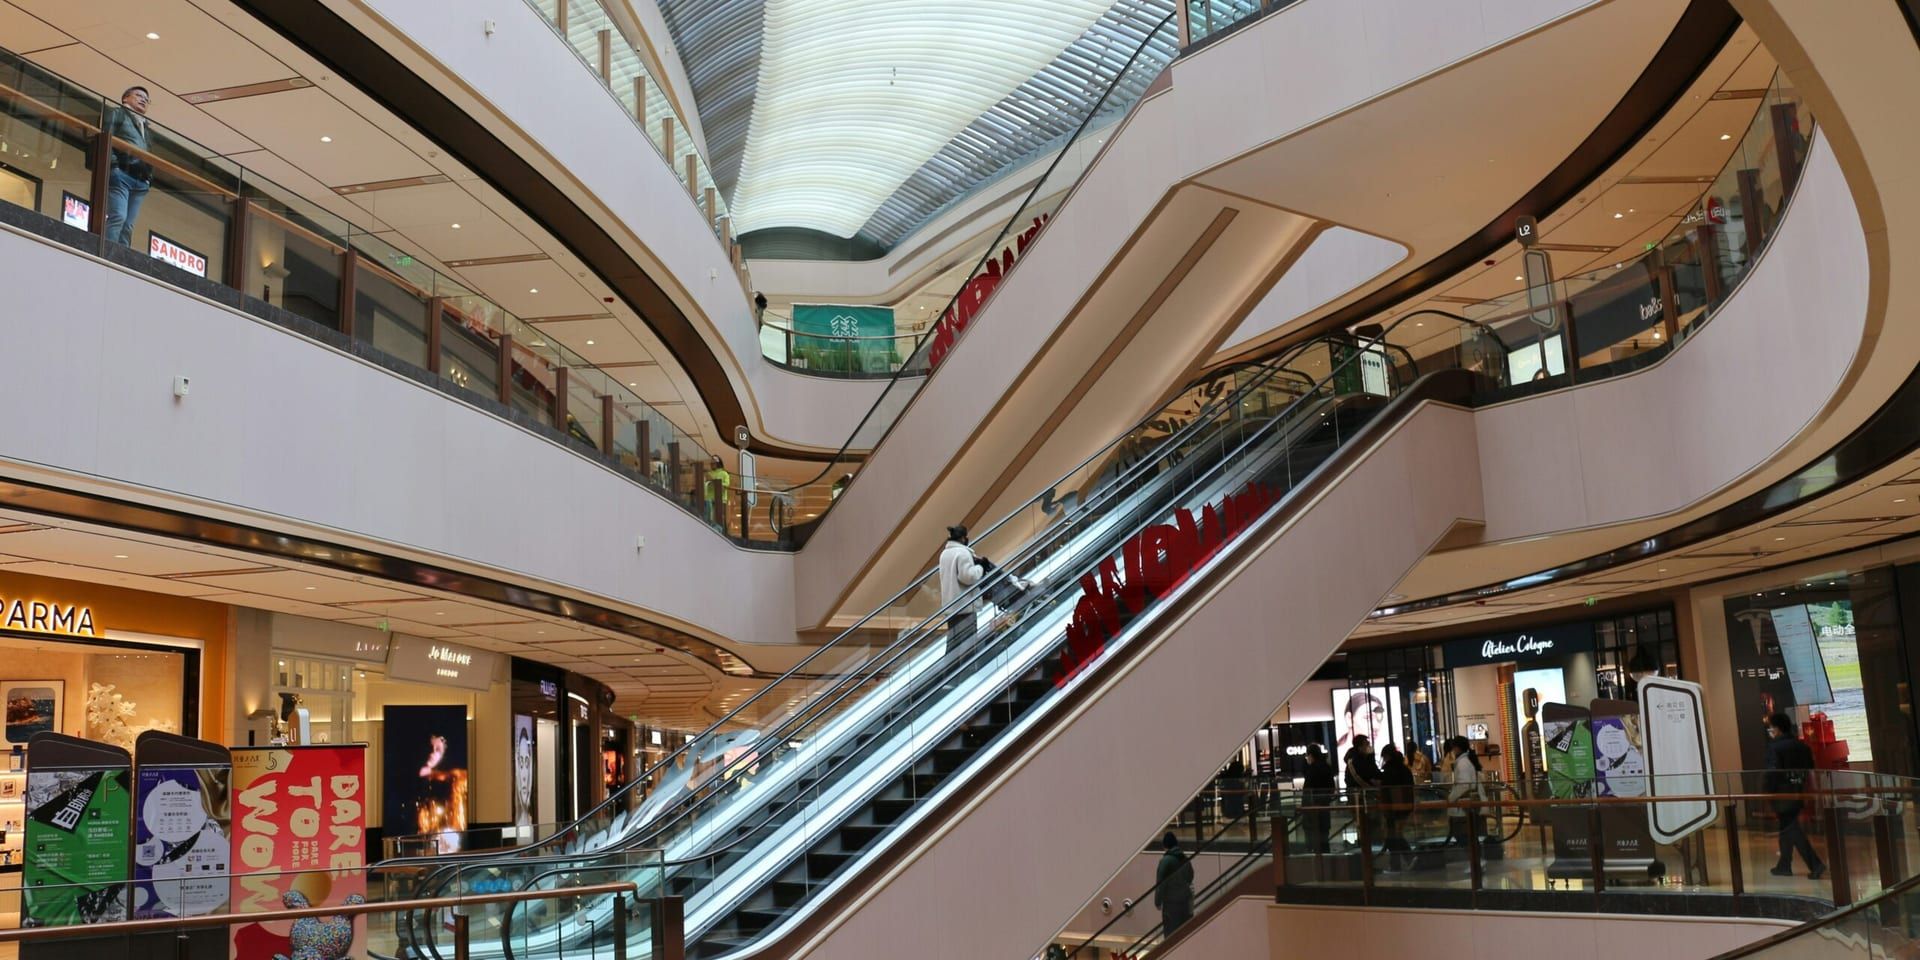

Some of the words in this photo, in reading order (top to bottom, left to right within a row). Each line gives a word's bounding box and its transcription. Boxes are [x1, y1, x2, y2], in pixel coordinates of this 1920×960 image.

[151, 238, 204, 272] SANDRO
[1481, 640, 1516, 658] Atelier
[1516, 634, 1554, 655] Cologne
[1286, 744, 1328, 756] CHAL
[288, 775, 322, 838] TO
[329, 775, 361, 881] DARE
[238, 780, 281, 922] WOW
[292, 841, 301, 869] MORE
[301, 841, 310, 861] FOR
[310, 841, 319, 865] DARE
